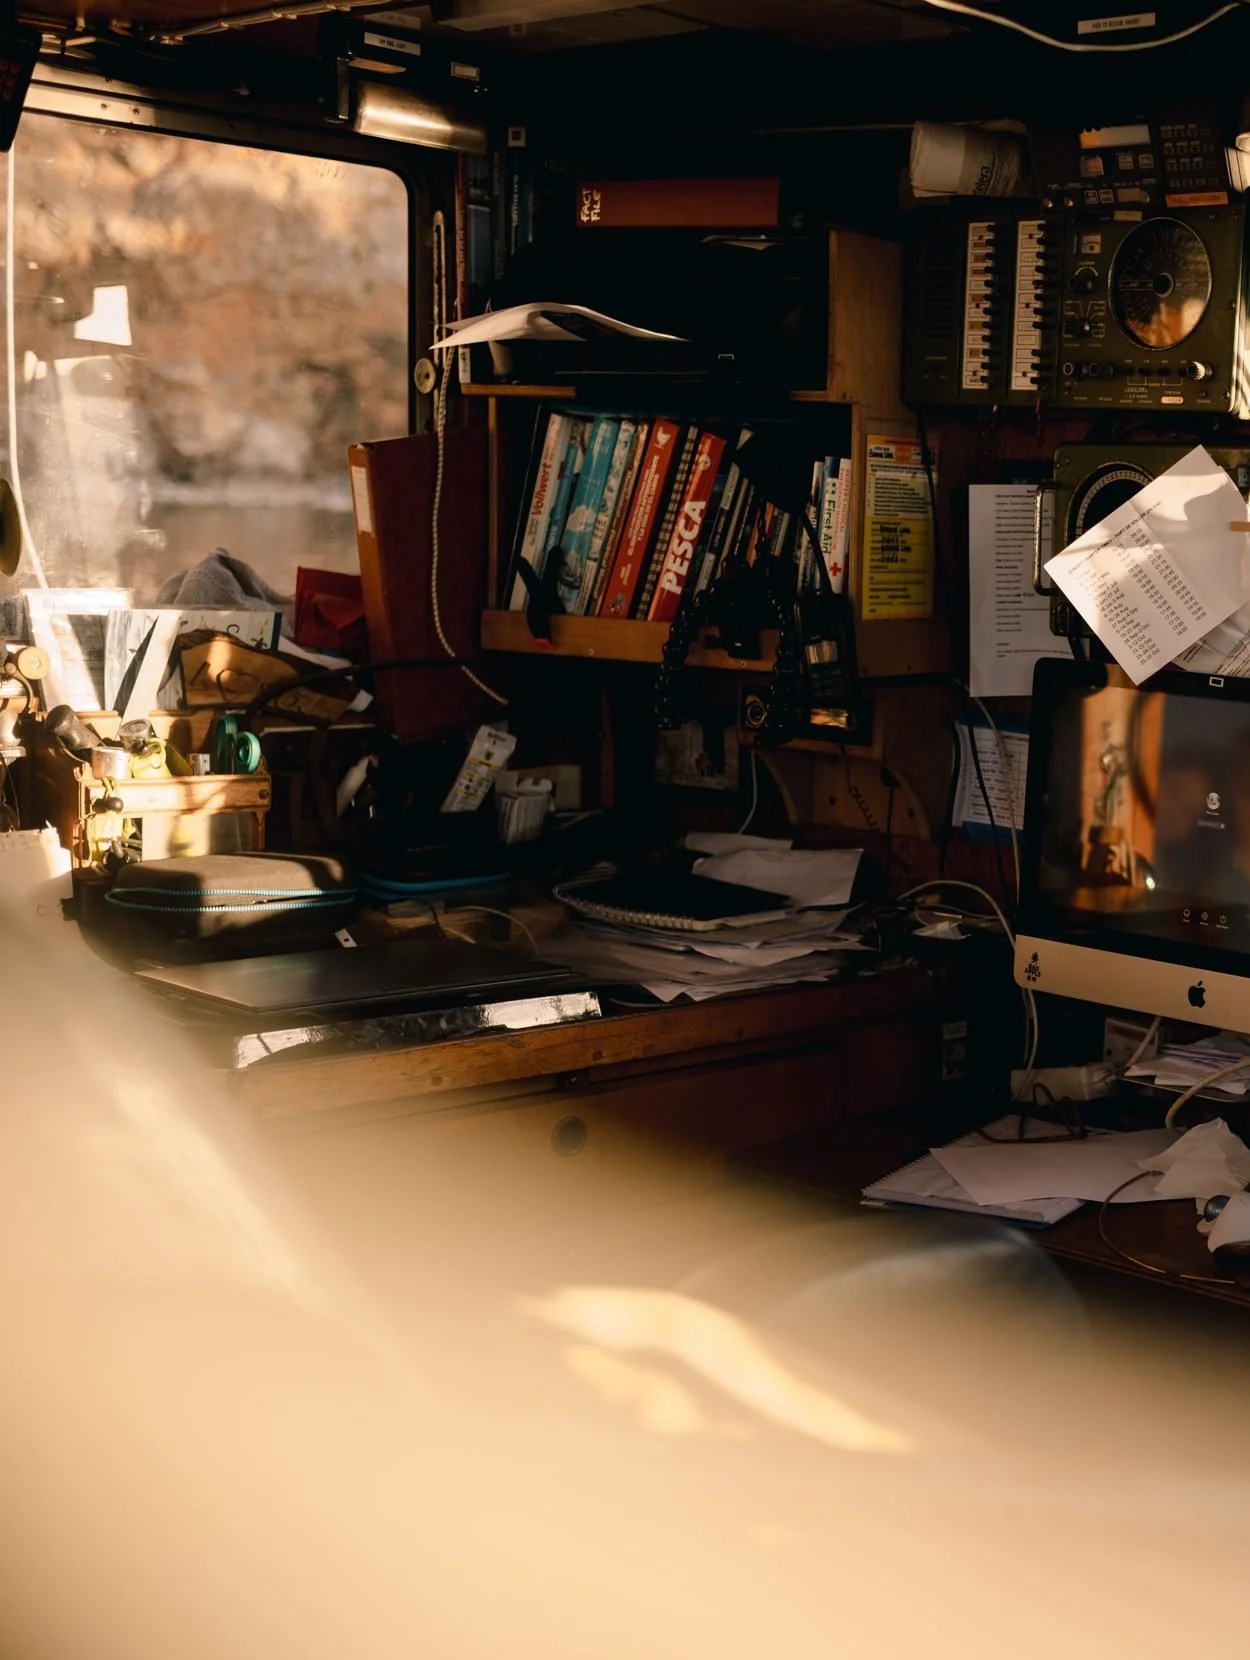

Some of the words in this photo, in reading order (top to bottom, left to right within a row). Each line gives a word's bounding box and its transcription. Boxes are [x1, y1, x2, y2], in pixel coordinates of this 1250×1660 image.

[580, 187, 591, 223] FACT
[591, 190, 601, 223] FILE
[530, 462, 553, 516] Vollwert
[836, 468, 846, 509] EMERGENCY
[824, 499, 836, 530] First
[838, 503, 848, 533] MEDICAL
[658, 495, 710, 594] PESCA
